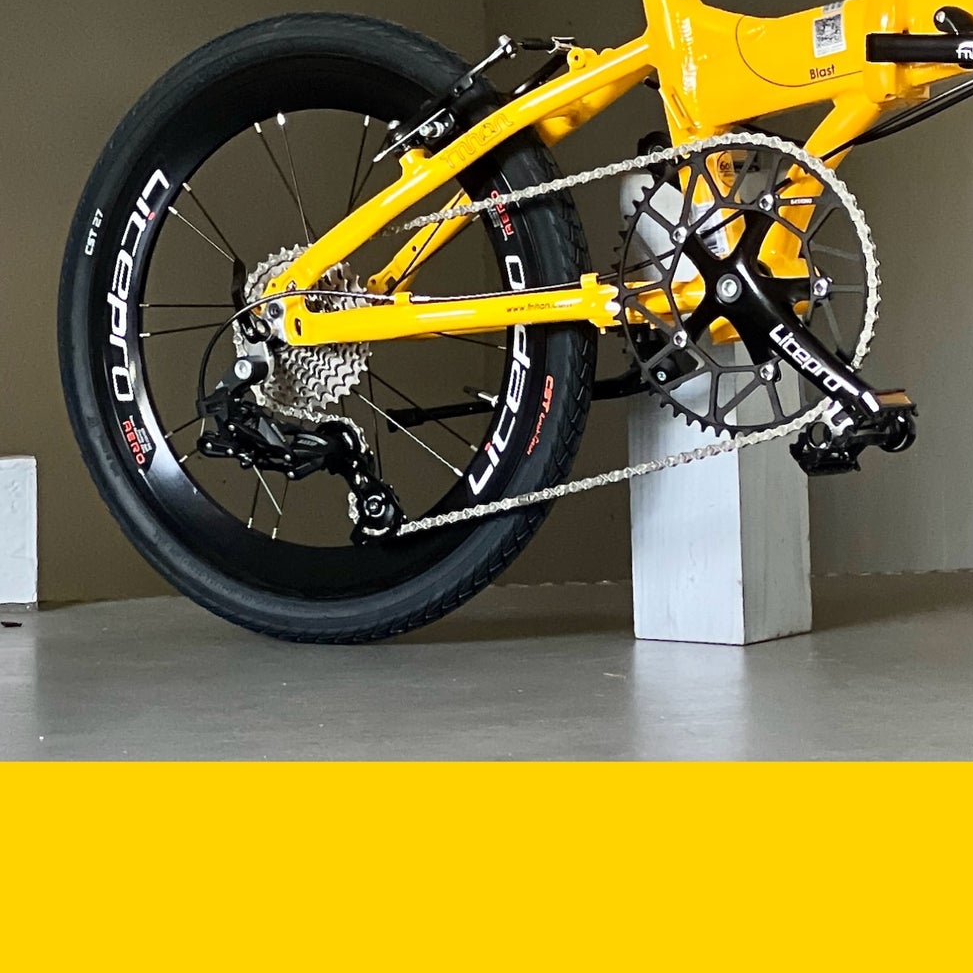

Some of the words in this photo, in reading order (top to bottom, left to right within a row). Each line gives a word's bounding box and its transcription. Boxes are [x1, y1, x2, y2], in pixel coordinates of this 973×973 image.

[809, 64, 836, 80] Blast
[84, 228, 98, 256] CST
[92, 208, 103, 228] 27
[469, 255, 530, 495] Litepo
[123, 420, 146, 465] AERO
